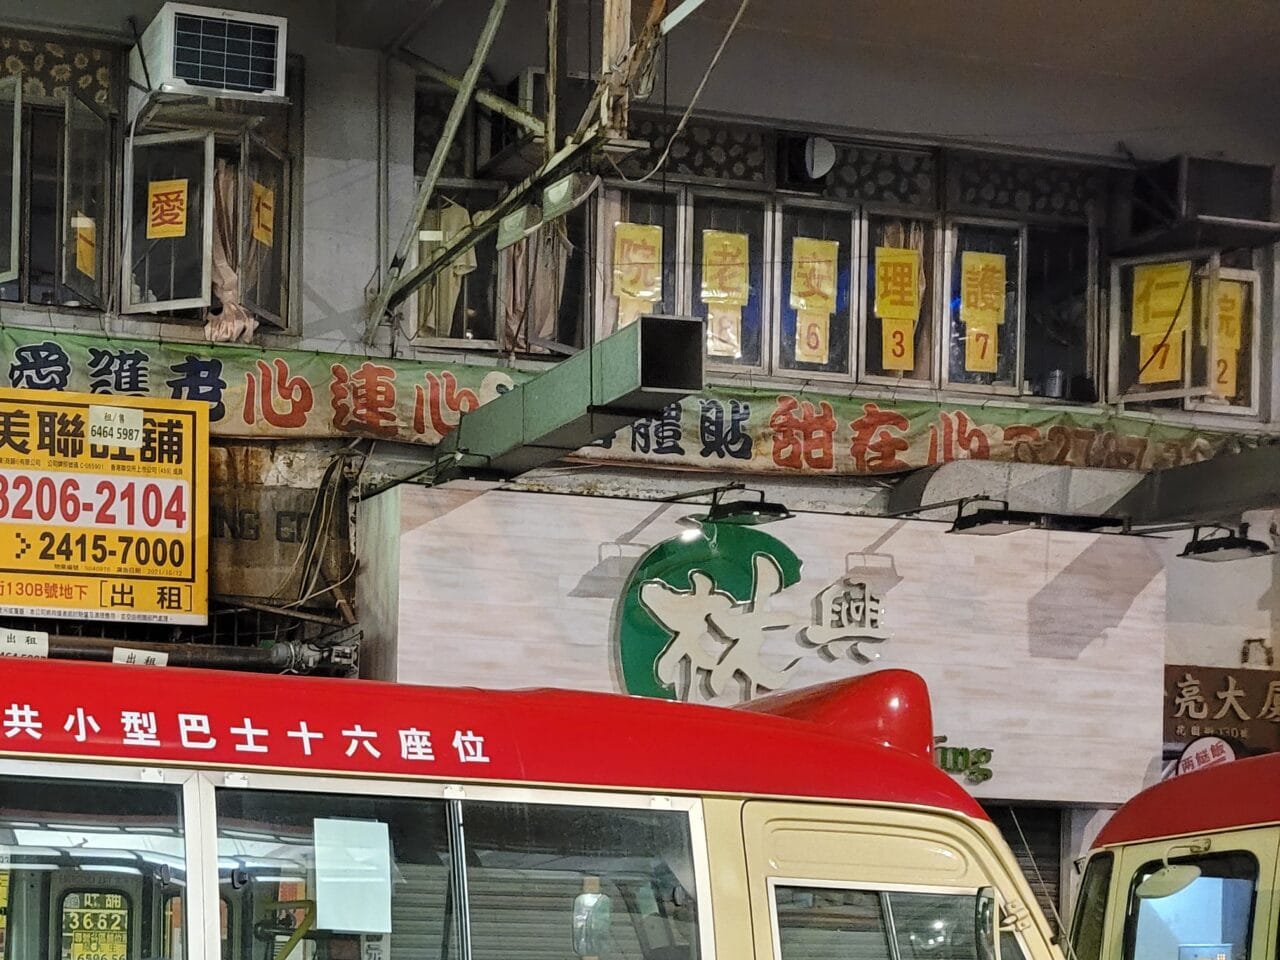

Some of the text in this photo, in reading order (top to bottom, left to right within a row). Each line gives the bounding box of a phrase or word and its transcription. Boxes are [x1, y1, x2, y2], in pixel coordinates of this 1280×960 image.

[152, 189, 184, 228] 愛
[879, 261, 914, 308] 理
[806, 323, 819, 350] 6
[891, 330, 906, 358] 3
[975, 334, 990, 361] 7
[1216, 358, 1229, 385] 2
[90, 424, 140, 441] 6464 5987
[38, 531, 185, 568] 2415-7000
